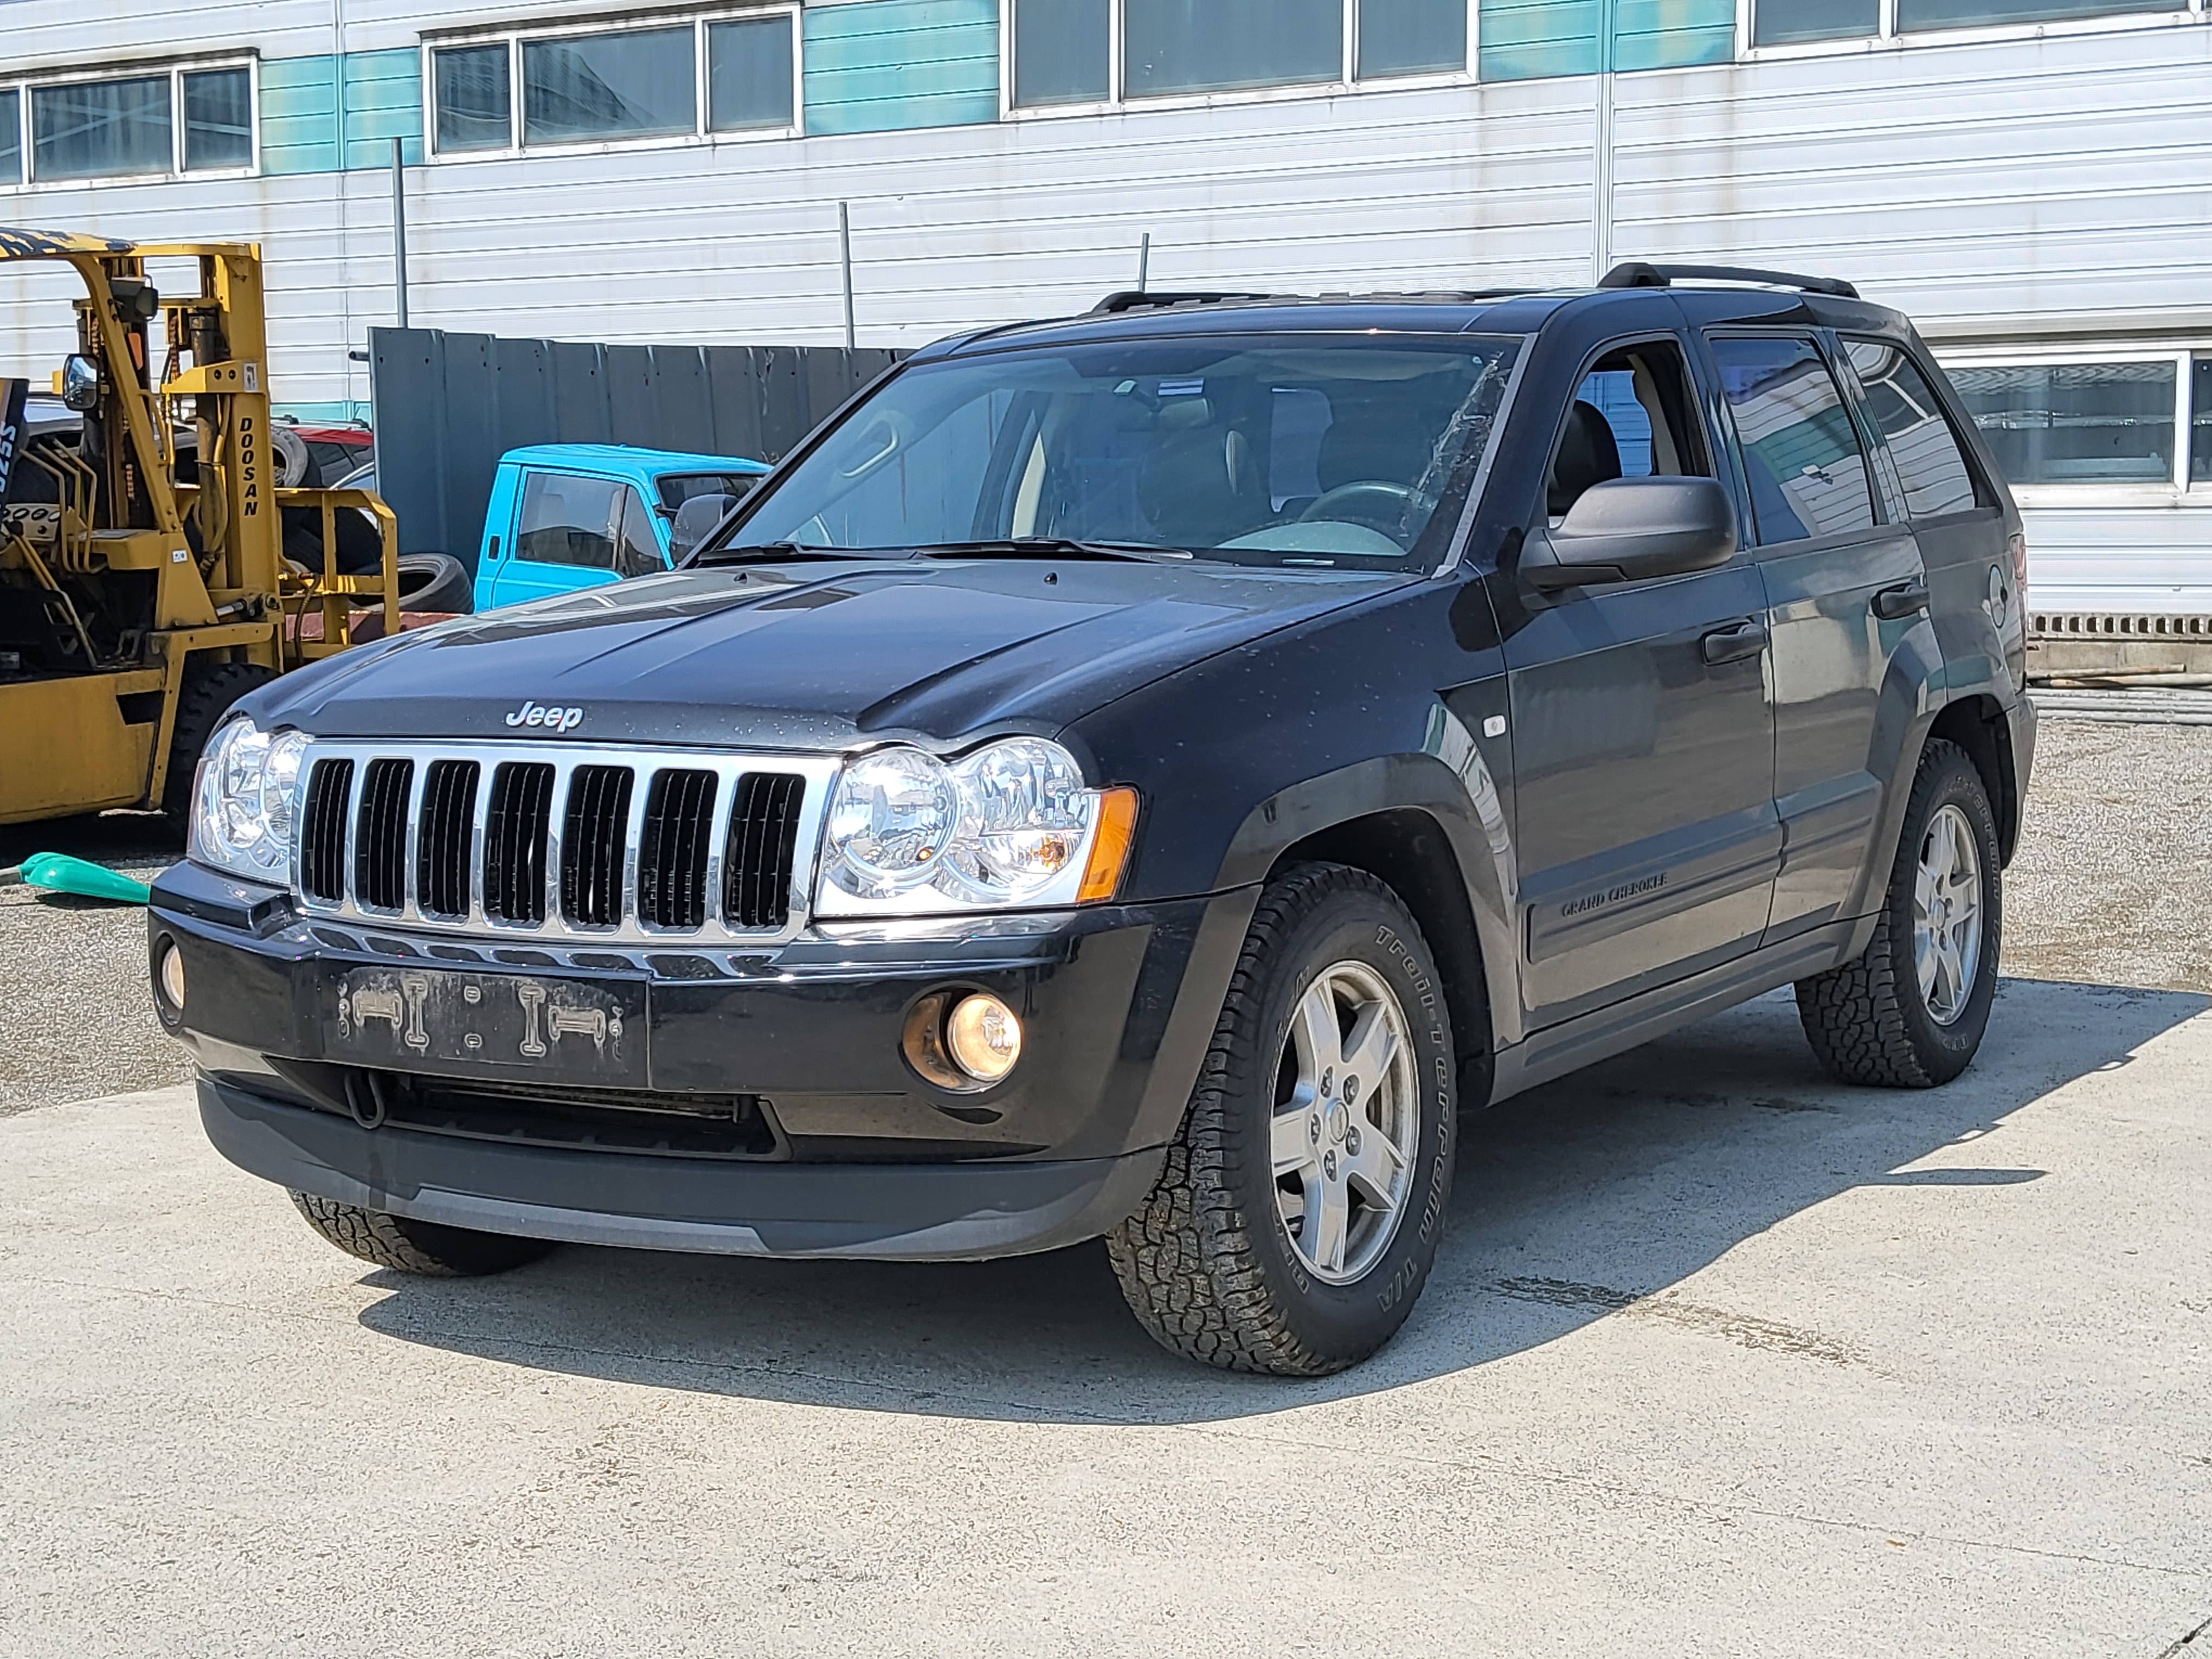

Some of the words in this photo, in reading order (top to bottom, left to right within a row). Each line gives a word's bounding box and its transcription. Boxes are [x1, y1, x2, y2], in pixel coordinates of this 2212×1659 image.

[240, 417, 258, 516] DOOSAN
[506, 700, 583, 734] Jeep
[1562, 893, 1605, 917] GRAND
[1608, 872, 1668, 902] CHEROKEE
[1375, 925, 1449, 1244] Trail-Terrain
